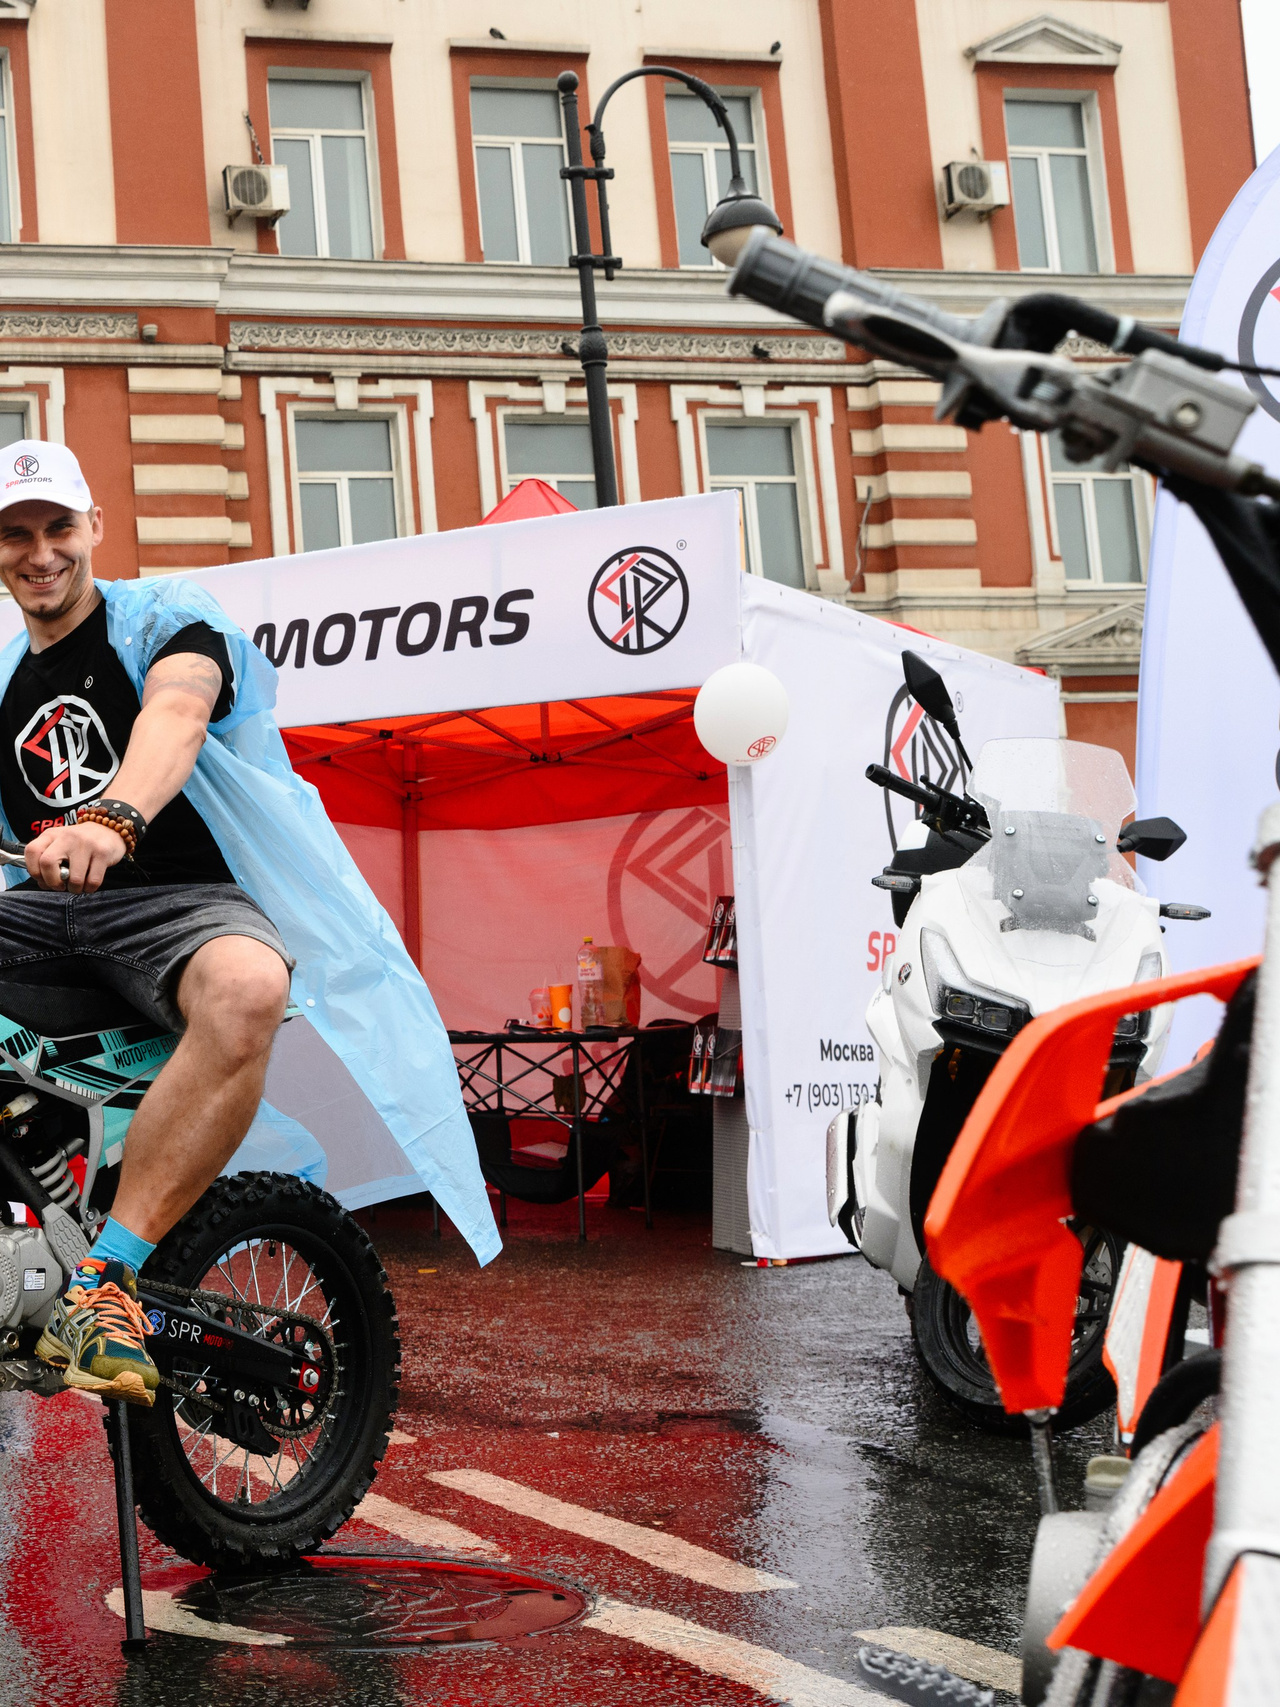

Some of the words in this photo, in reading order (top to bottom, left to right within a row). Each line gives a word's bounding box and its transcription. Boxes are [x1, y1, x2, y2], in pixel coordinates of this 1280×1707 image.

[252, 588, 535, 669] MOTORS
[113, 1042, 160, 1070] MOTOPRO
[820, 1038, 874, 1061] Москва
[785, 1083, 803, 1107] +7
[808, 1081, 845, 1114] (903)
[168, 1318, 203, 1344] SPR
